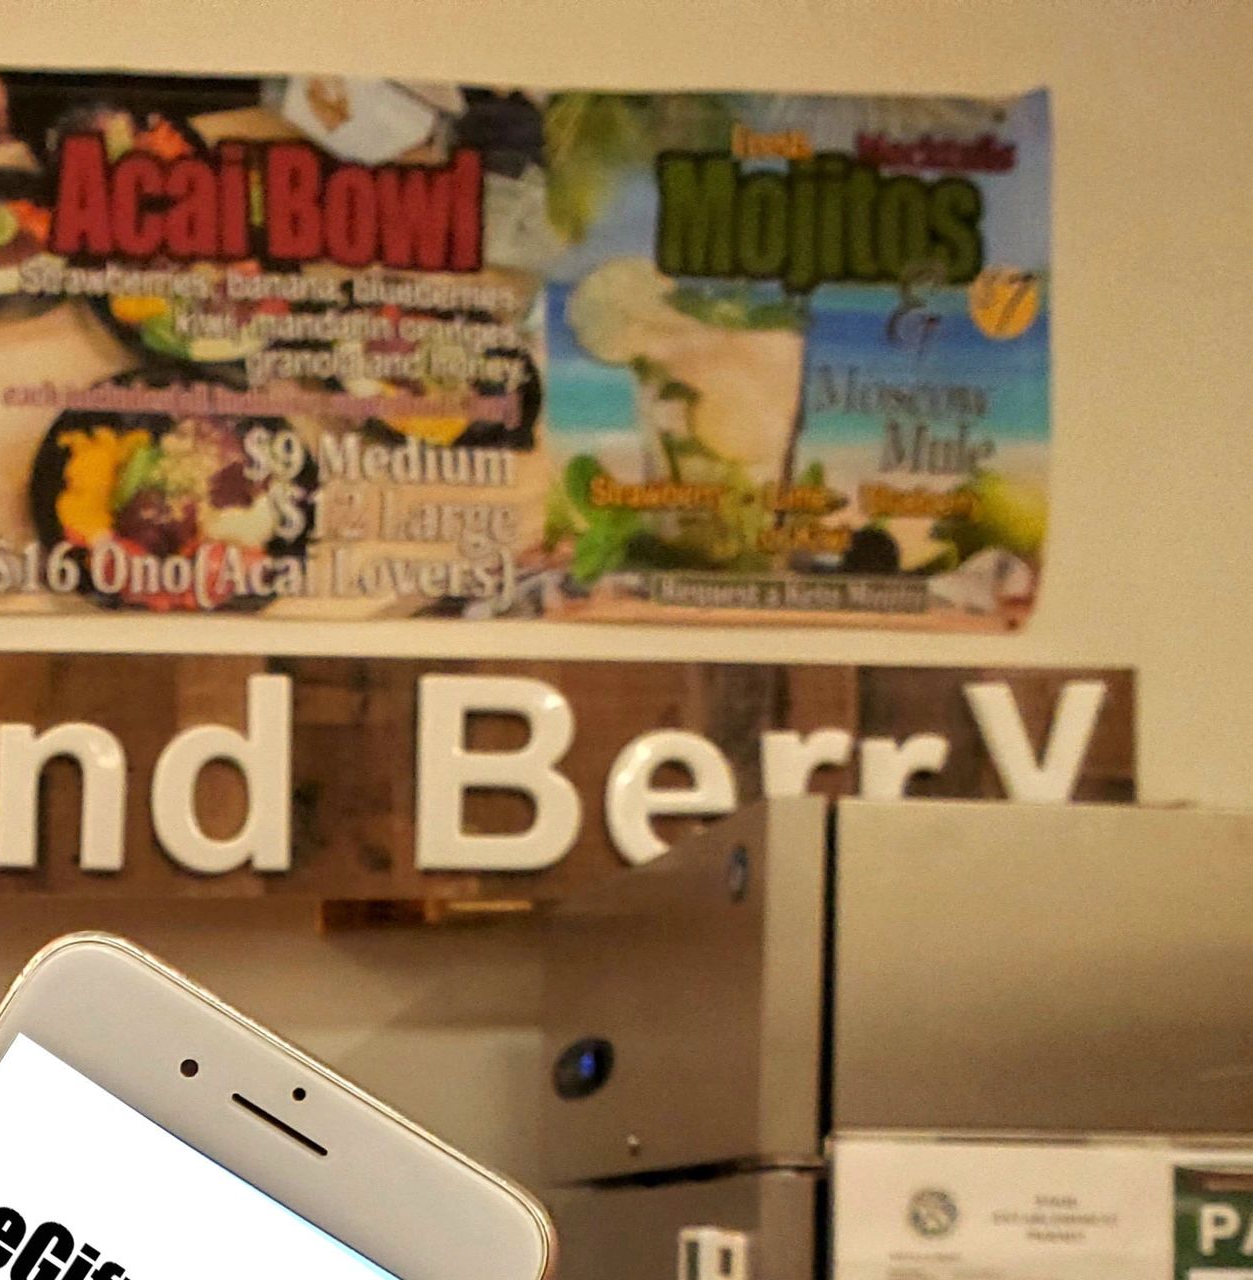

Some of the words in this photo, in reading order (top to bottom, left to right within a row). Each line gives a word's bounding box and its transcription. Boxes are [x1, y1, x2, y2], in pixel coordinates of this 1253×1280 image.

[53, 133, 246, 257] Acai
[268, 140, 482, 271] Bowl
[658, 153, 983, 294] Mojitos
[244, 427, 306, 484] $9
[318, 434, 515, 487] Medium
[273, 482, 369, 540] $12
[379, 488, 522, 561] Large
[1199, 1203, 1253, 1257] P
